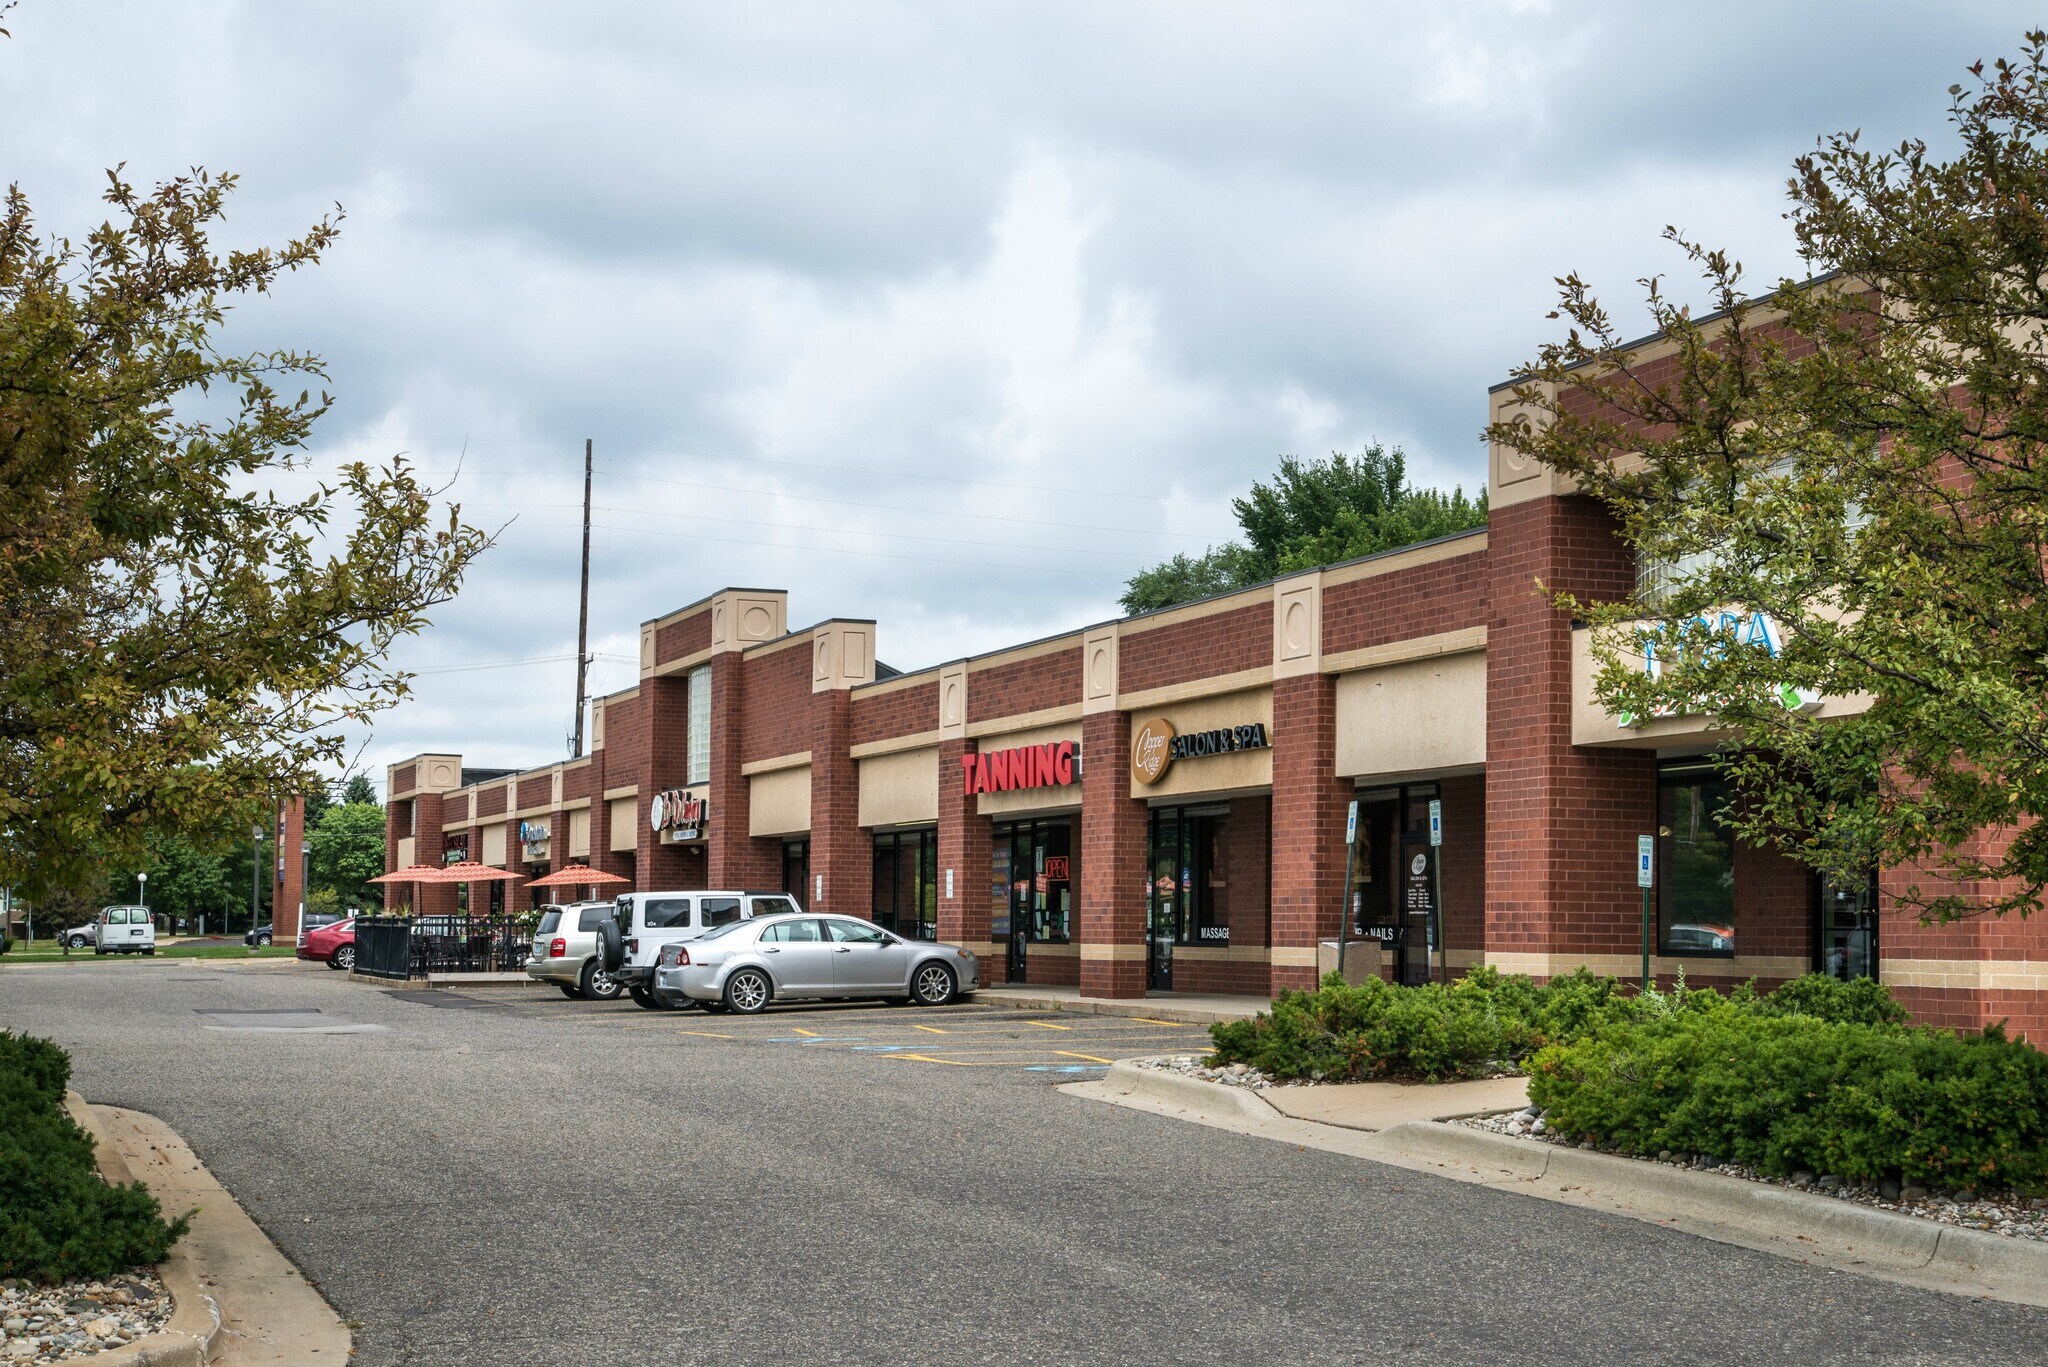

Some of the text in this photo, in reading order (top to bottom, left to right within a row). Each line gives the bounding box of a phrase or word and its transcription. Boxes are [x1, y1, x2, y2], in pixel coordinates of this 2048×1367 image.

[1170, 723, 1264, 760] SALON & SPA
[961, 740, 1074, 794] TANNING
[1046, 859, 1068, 878] OPEN
[1201, 927, 1229, 939] MASSAGE
[1370, 928, 1394, 940] NAILS
